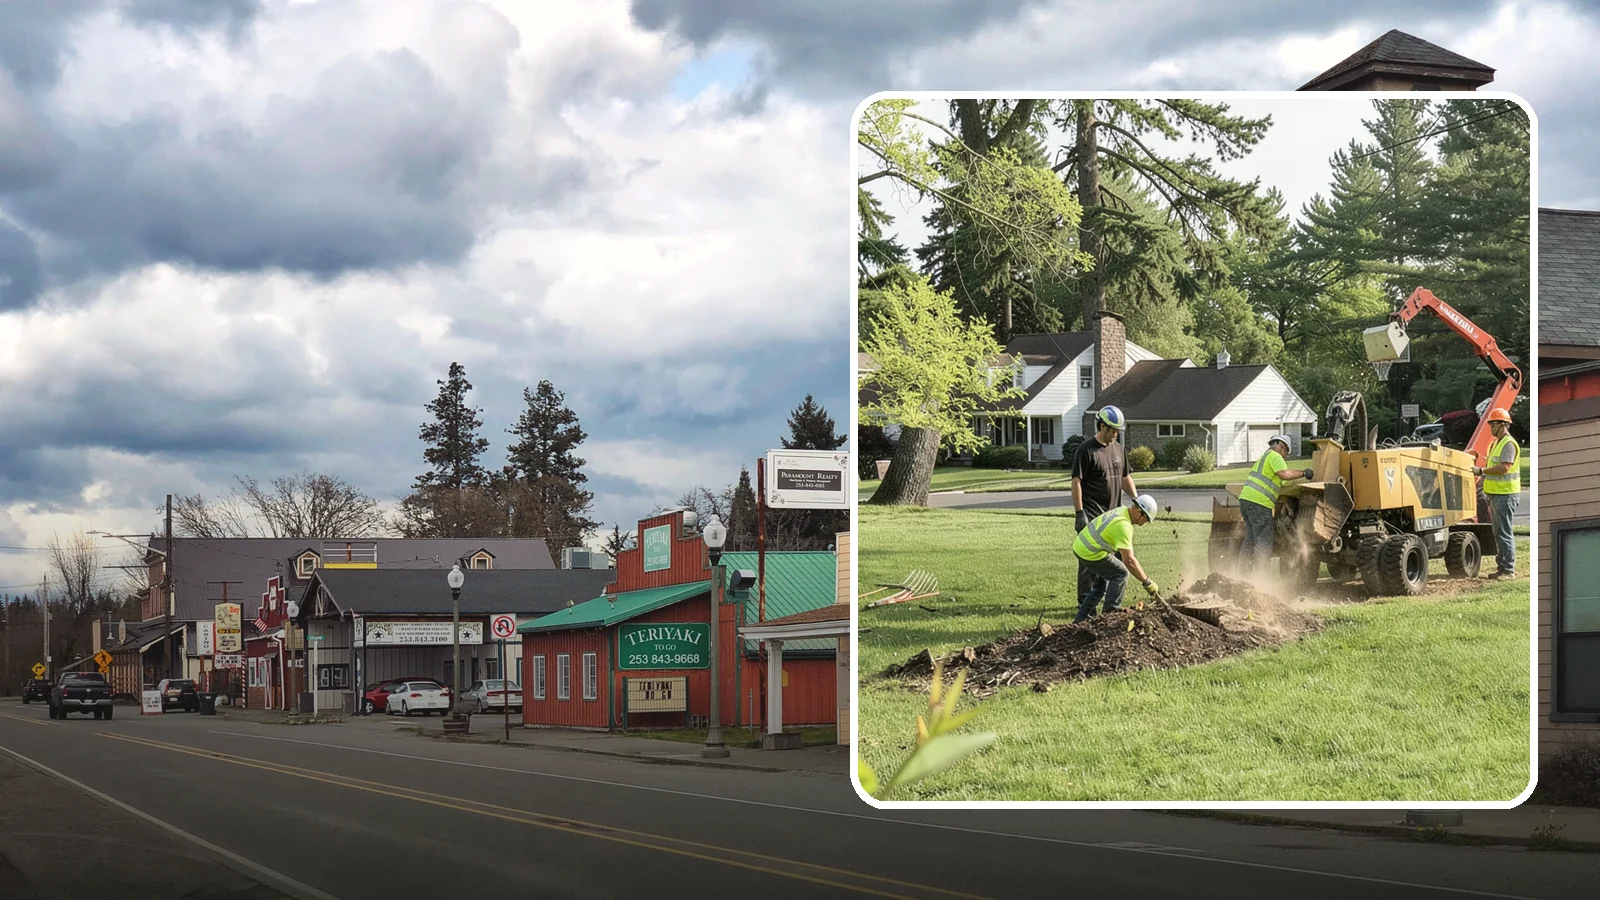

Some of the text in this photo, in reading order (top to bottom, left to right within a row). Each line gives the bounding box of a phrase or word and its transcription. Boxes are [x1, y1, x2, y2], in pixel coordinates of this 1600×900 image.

[646, 530, 669, 549] TERIYAKI
[624, 627, 703, 647] TERIYAKI
[628, 653, 700, 665] 253 843-9668
[639, 681, 673, 691] TERIYAKI
